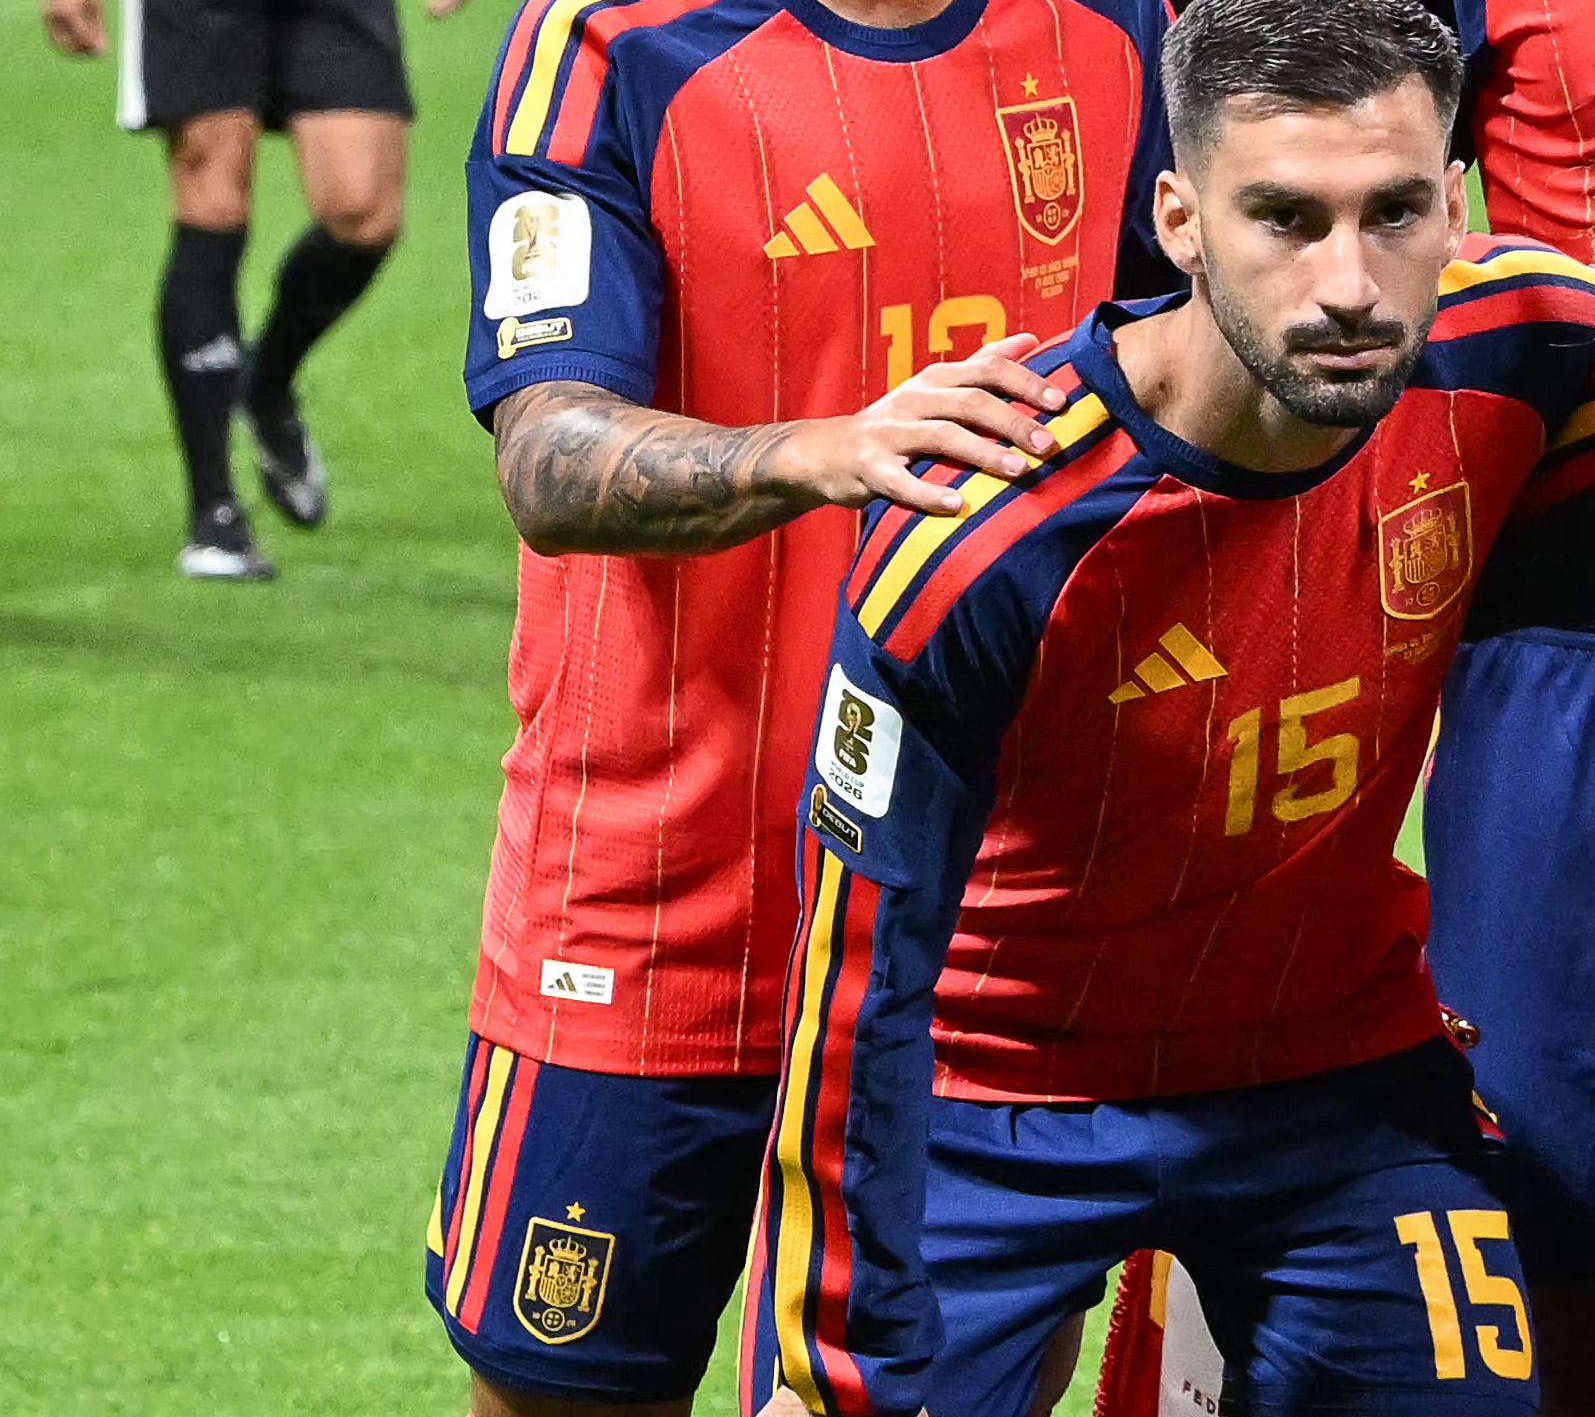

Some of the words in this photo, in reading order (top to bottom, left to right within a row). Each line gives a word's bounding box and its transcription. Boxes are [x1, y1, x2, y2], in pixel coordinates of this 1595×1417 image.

[822, 808, 858, 838] DEBUT
[1224, 676, 1360, 836] 15
[1393, 1209, 1532, 1380] 15
